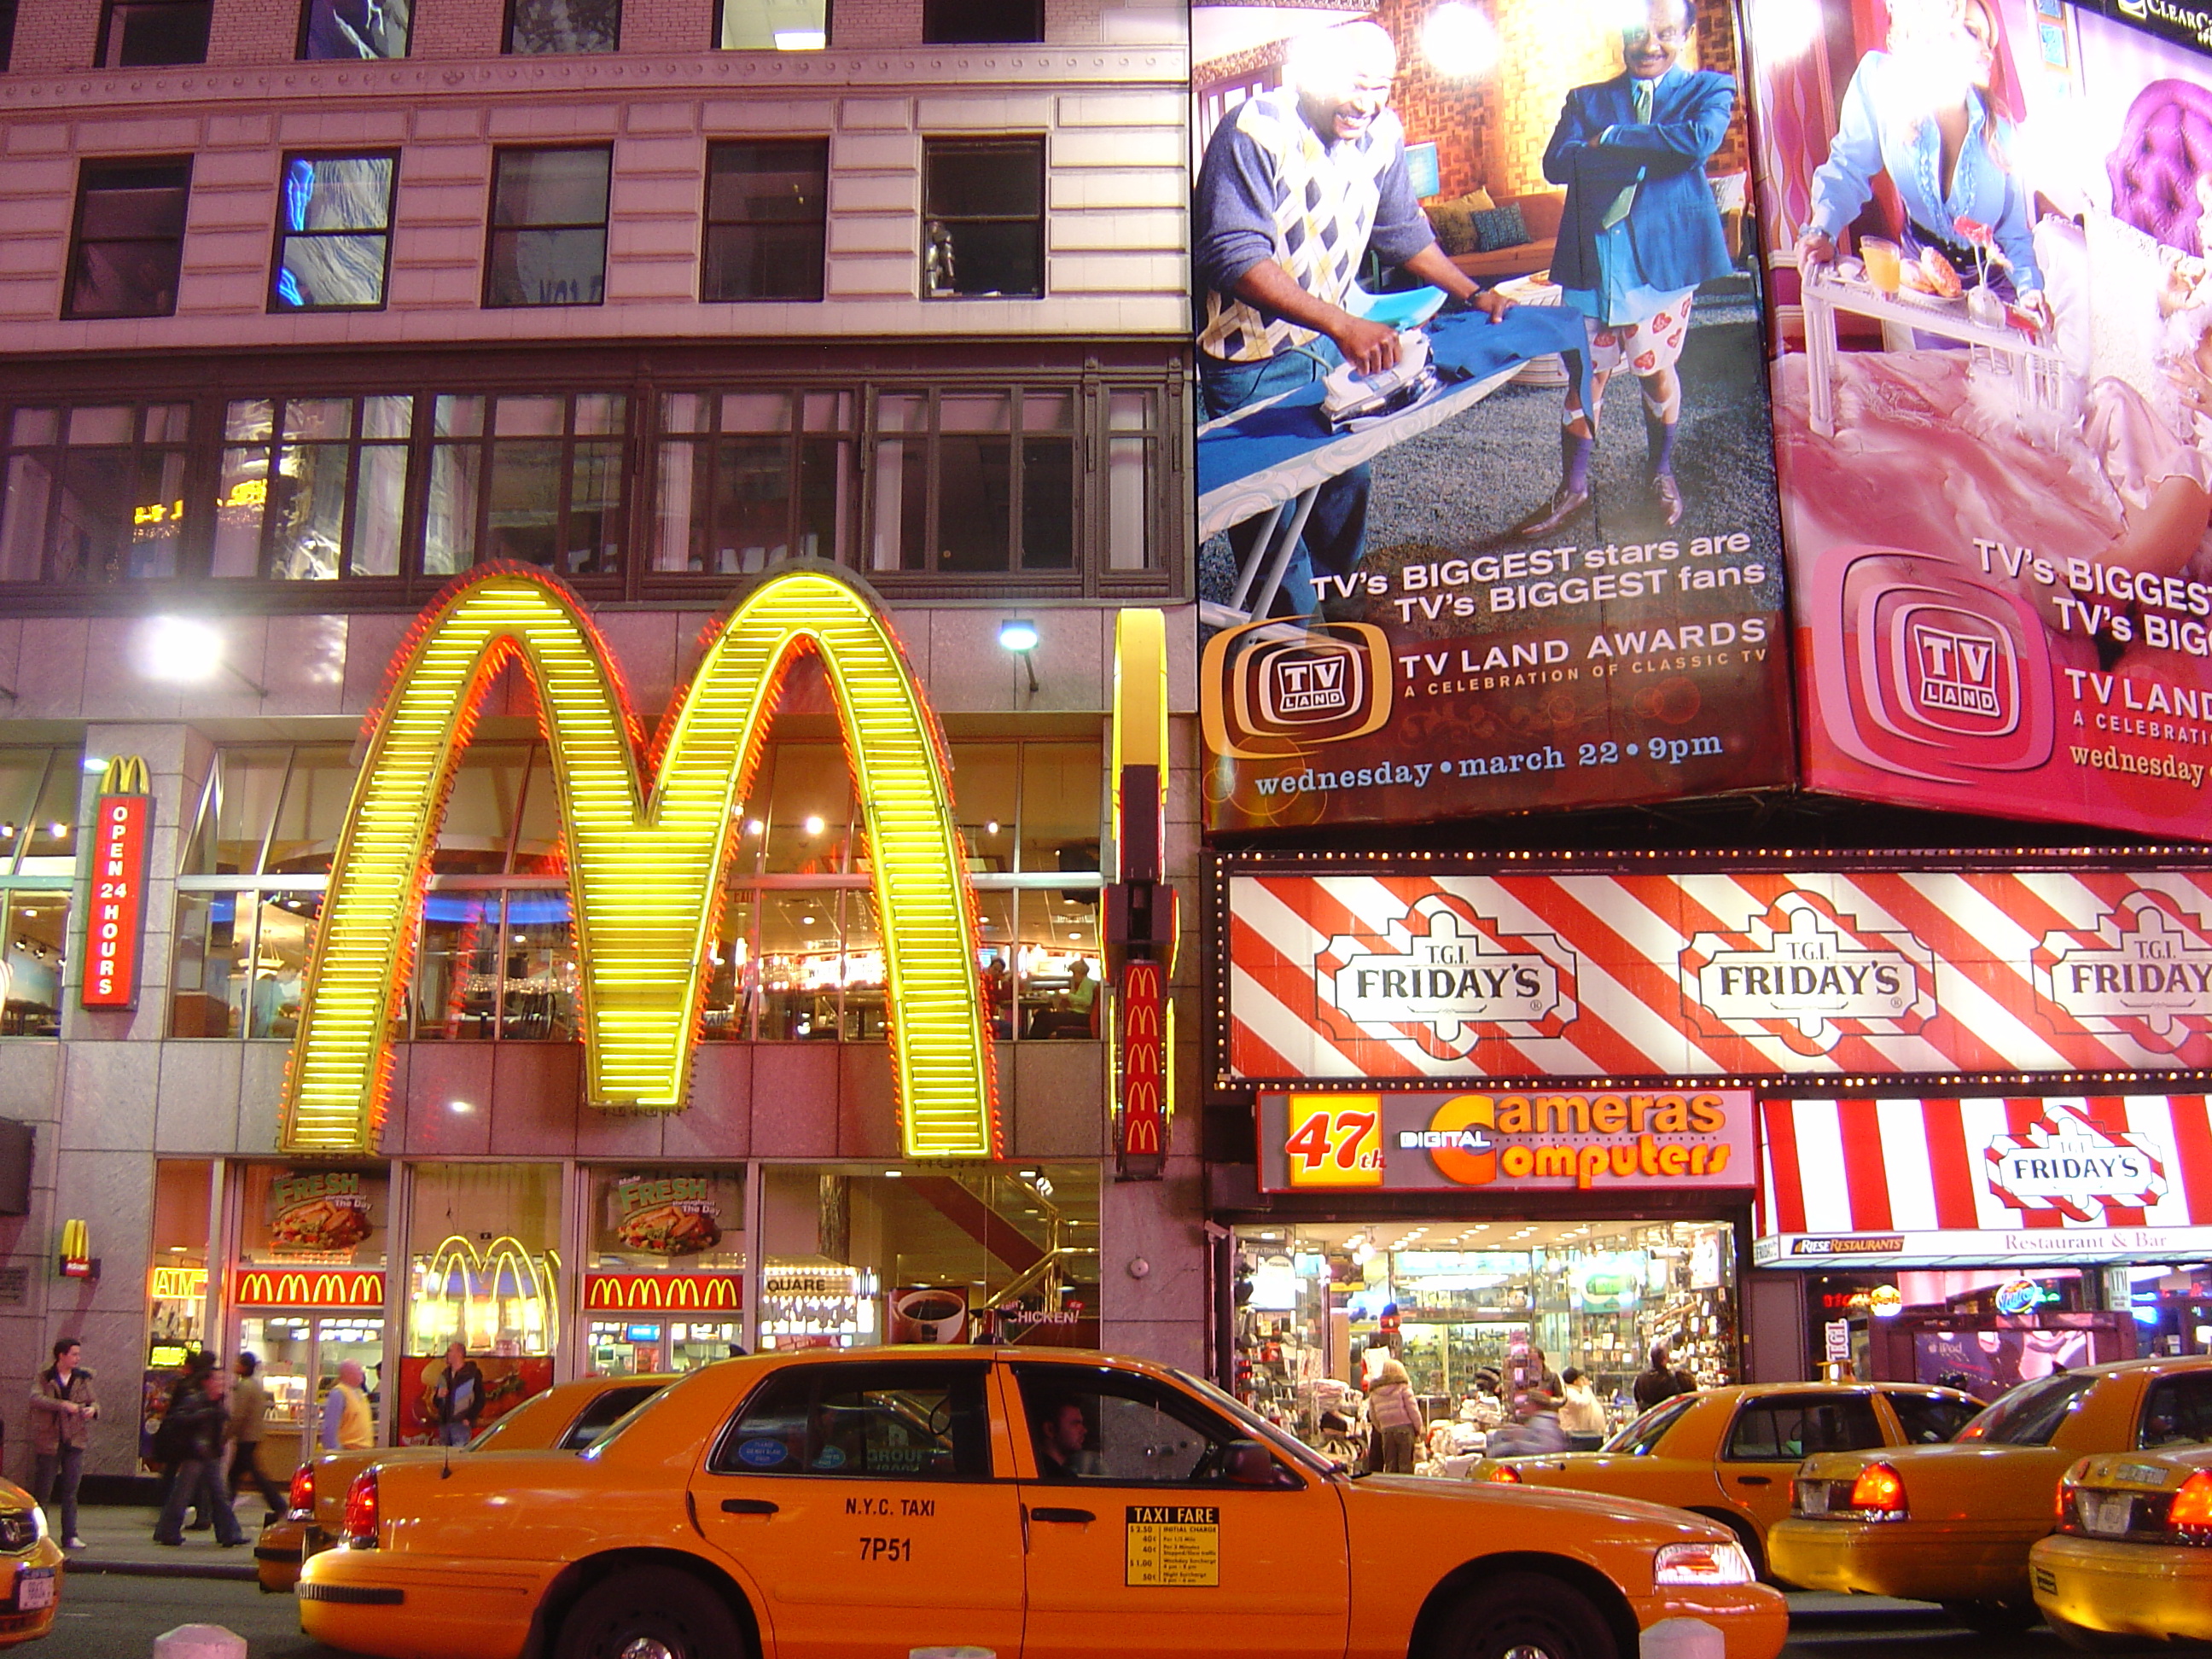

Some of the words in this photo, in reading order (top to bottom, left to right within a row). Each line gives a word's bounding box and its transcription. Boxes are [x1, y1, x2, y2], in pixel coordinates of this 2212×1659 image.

[2147, 0, 2212, 32] CLEARC
[1310, 569, 1389, 602] TV's
[1402, 547, 1578, 592] BIGGEST
[1584, 538, 1679, 569] stars
[1689, 532, 1751, 556] are
[1973, 536, 2056, 586] TV's
[1394, 595, 1475, 625] TV's
[1490, 568, 1668, 614] BIGGEST
[1677, 562, 1766, 591] fans
[2052, 596, 2133, 643] TV's
[2144, 614, 2212, 657] BIG
[1399, 653, 1449, 679] TV
[1460, 639, 1569, 672] LAND
[1586, 618, 1767, 660] AWARDS
[1924, 636, 1991, 683] TV
[1284, 658, 1344, 693] TV
[1404, 685, 1416, 698] A
[1428, 667, 1580, 696] CELEBRATION
[1592, 661, 1618, 678] OF
[1631, 654, 1730, 674] CLASSIC
[1741, 648, 1767, 662] TV
[2064, 668, 2114, 705] TV
[1284, 690, 1343, 709] LAND
[1925, 684, 1994, 710] LAND
[2073, 710, 2084, 727] A
[2095, 713, 2212, 747] CELEBRATI
[1254, 760, 1433, 797] wednesday
[1458, 748, 1566, 779] march
[1578, 743, 1620, 767] 22
[1646, 731, 1725, 762] 9pm
[2069, 743, 2205, 789] wednesday
[107, 806, 129, 876] OPEN
[100, 882, 127, 899] 24
[97, 904, 120, 996] HOURS
[1357, 963, 1541, 999] FRIDAY'S
[1719, 959, 1901, 996] FRIDAY'S
[1400, 1131, 1492, 1149] DIGITAL
[2014, 1154, 2139, 1179] FRIDAY'S
[274, 1173, 359, 1210] FRESH
[620, 1179, 707, 1214] FRESH
[2005, 1233, 2104, 1251] Restaurant
[2111, 1232, 2128, 1249] &
[2135, 1231, 2168, 1249] Bar
[156, 1270, 195, 1295] ATM
[845, 1498, 894, 1516] N.Y.C.
[900, 1499, 935, 1516] TAXI
[1134, 1507, 1169, 1523] TAXI
[1178, 1507, 1214, 1523] FARE
[859, 1537, 912, 1563] 7P51
